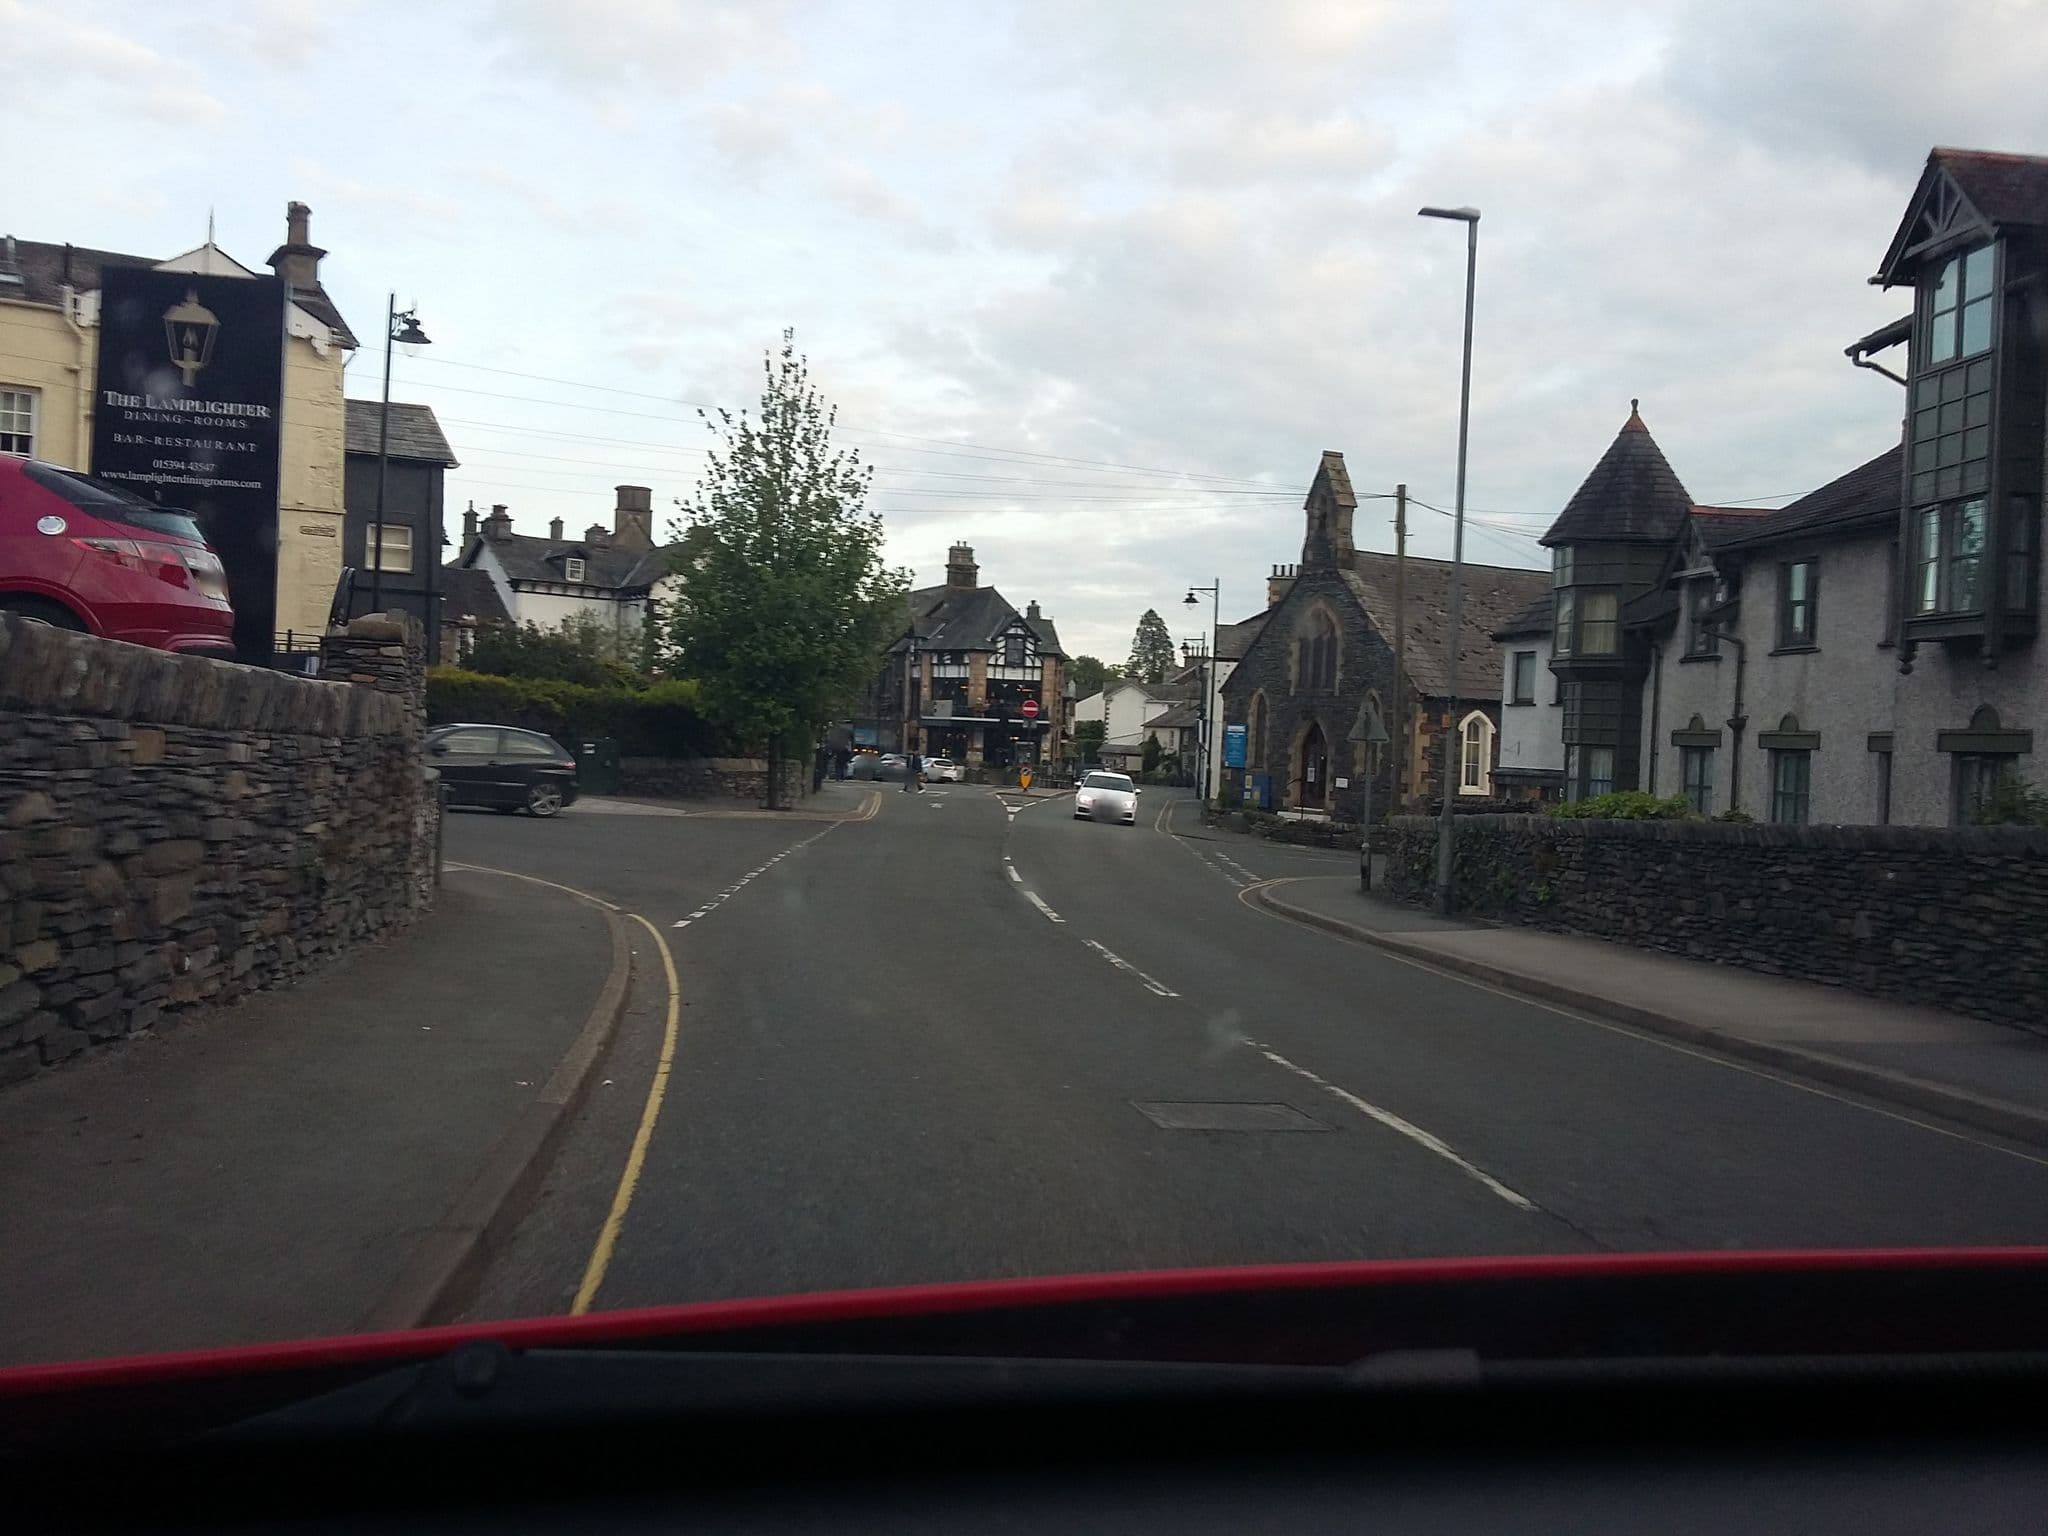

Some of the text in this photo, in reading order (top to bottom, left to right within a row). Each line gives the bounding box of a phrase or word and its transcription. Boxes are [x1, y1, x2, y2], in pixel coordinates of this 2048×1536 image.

[103, 390, 271, 418] THE LAMPLIGHTER
[101, 470, 262, 489] www.lamplighterdiningrooms.com
